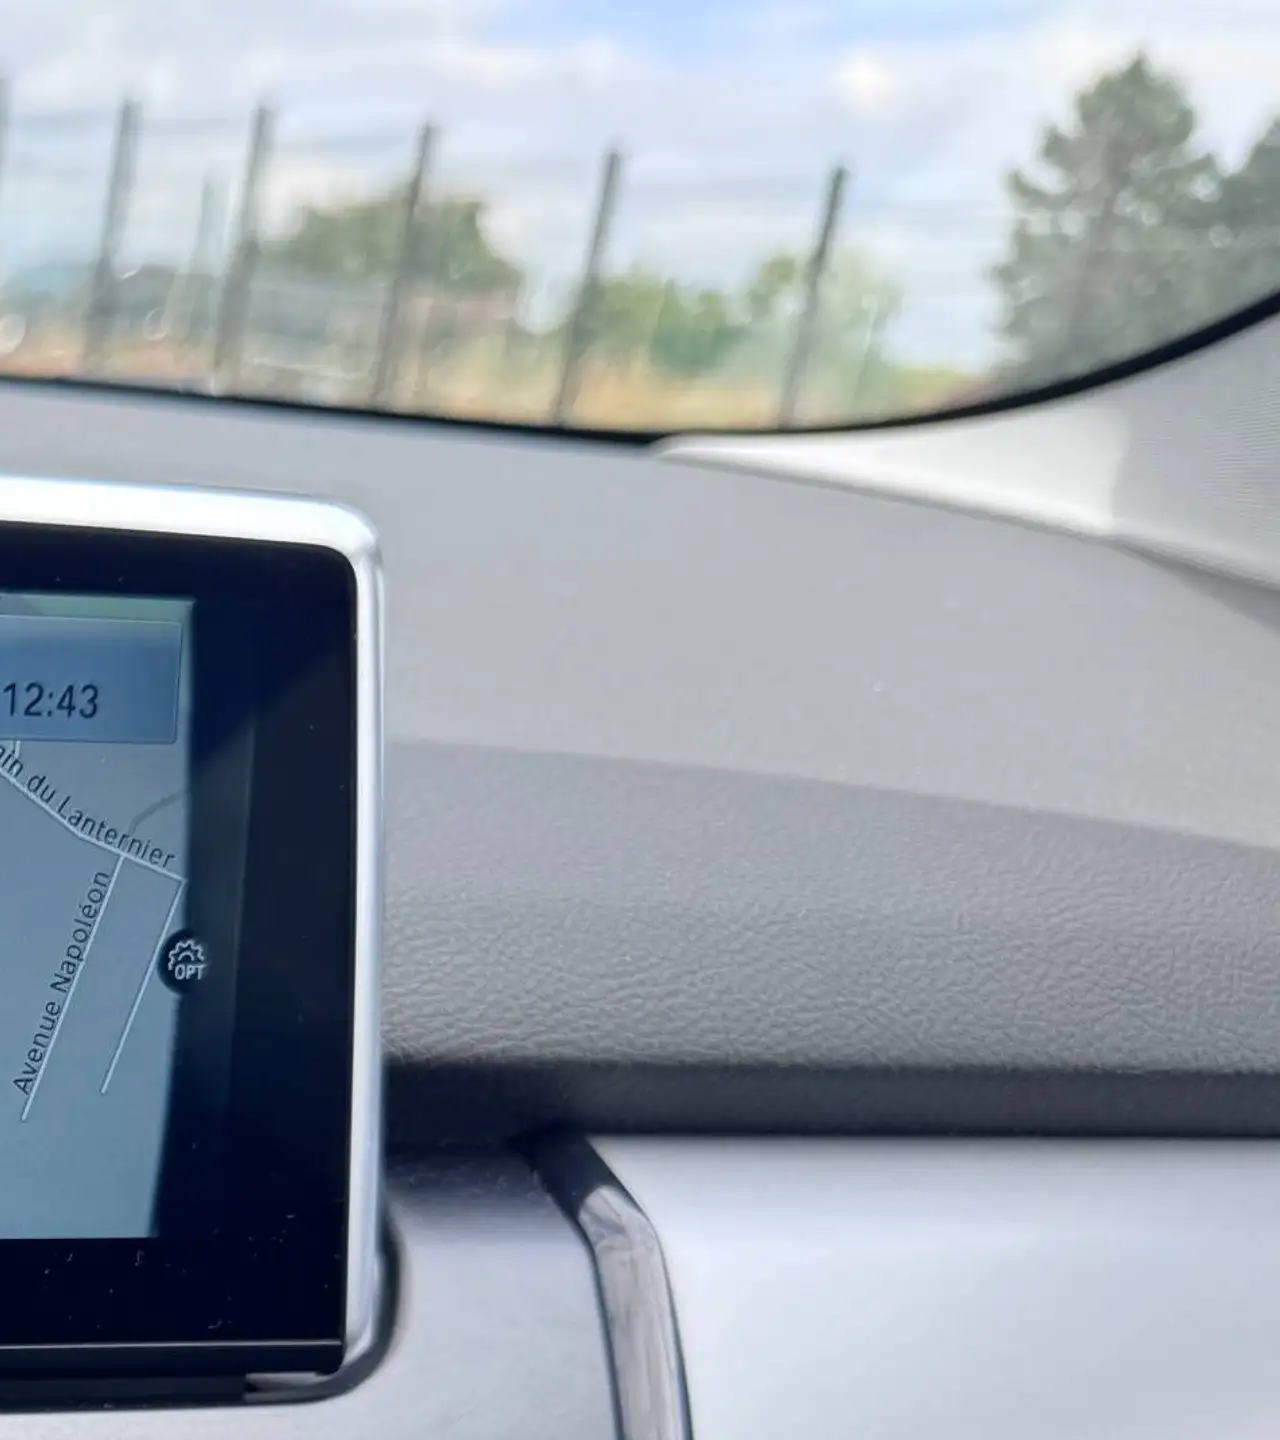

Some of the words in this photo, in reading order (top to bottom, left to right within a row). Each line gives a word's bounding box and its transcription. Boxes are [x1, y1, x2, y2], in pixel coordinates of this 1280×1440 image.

[3, 682, 99, 719] 12:43
[27, 775, 57, 804] du
[56, 796, 176, 868] Lanternier
[13, 1001, 61, 1095] Avenue
[50, 870, 111, 994] Napoléon
[175, 963, 205, 980] OPT
